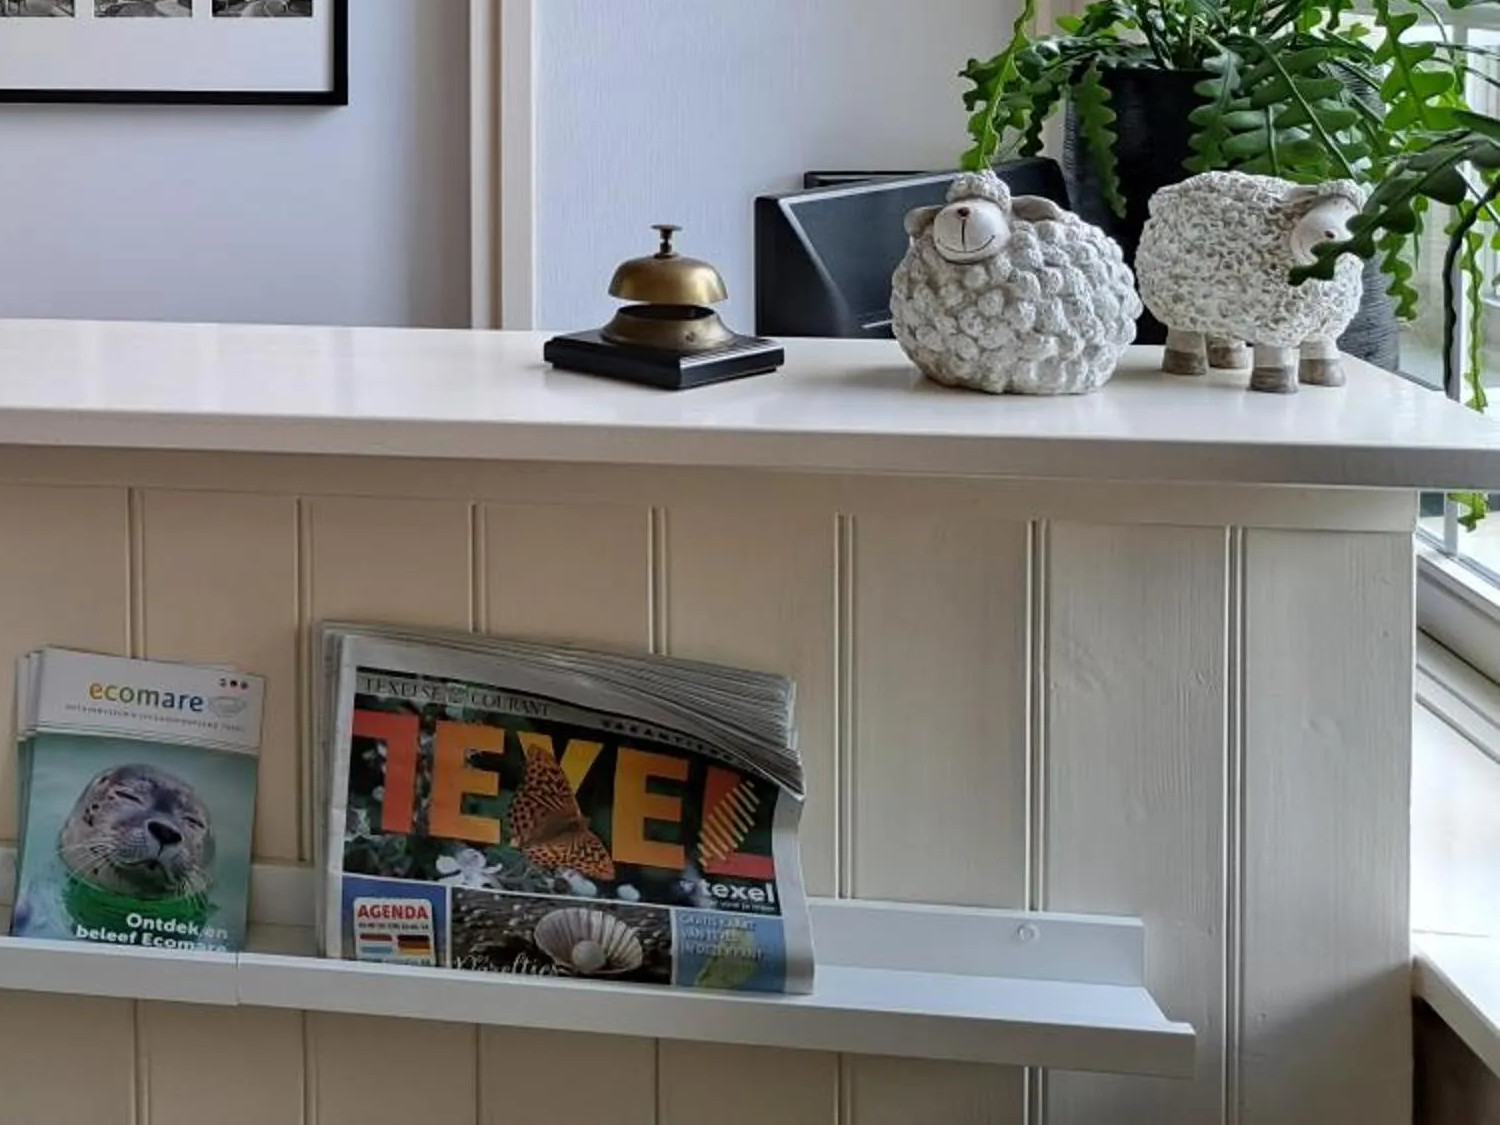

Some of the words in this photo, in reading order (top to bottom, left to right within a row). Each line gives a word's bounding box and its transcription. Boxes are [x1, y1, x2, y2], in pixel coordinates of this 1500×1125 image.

[89, 682, 204, 712] ecomare
[366, 677, 441, 700] TEXELSE
[470, 691, 550, 717] COURANT
[351, 709, 774, 881] TEXEL
[698, 878, 775, 904] texel
[357, 904, 429, 920] AGENDA
[75, 924, 137, 944] beleef
[126, 913, 200, 935] Ontdek
[204, 926, 228, 939] en
